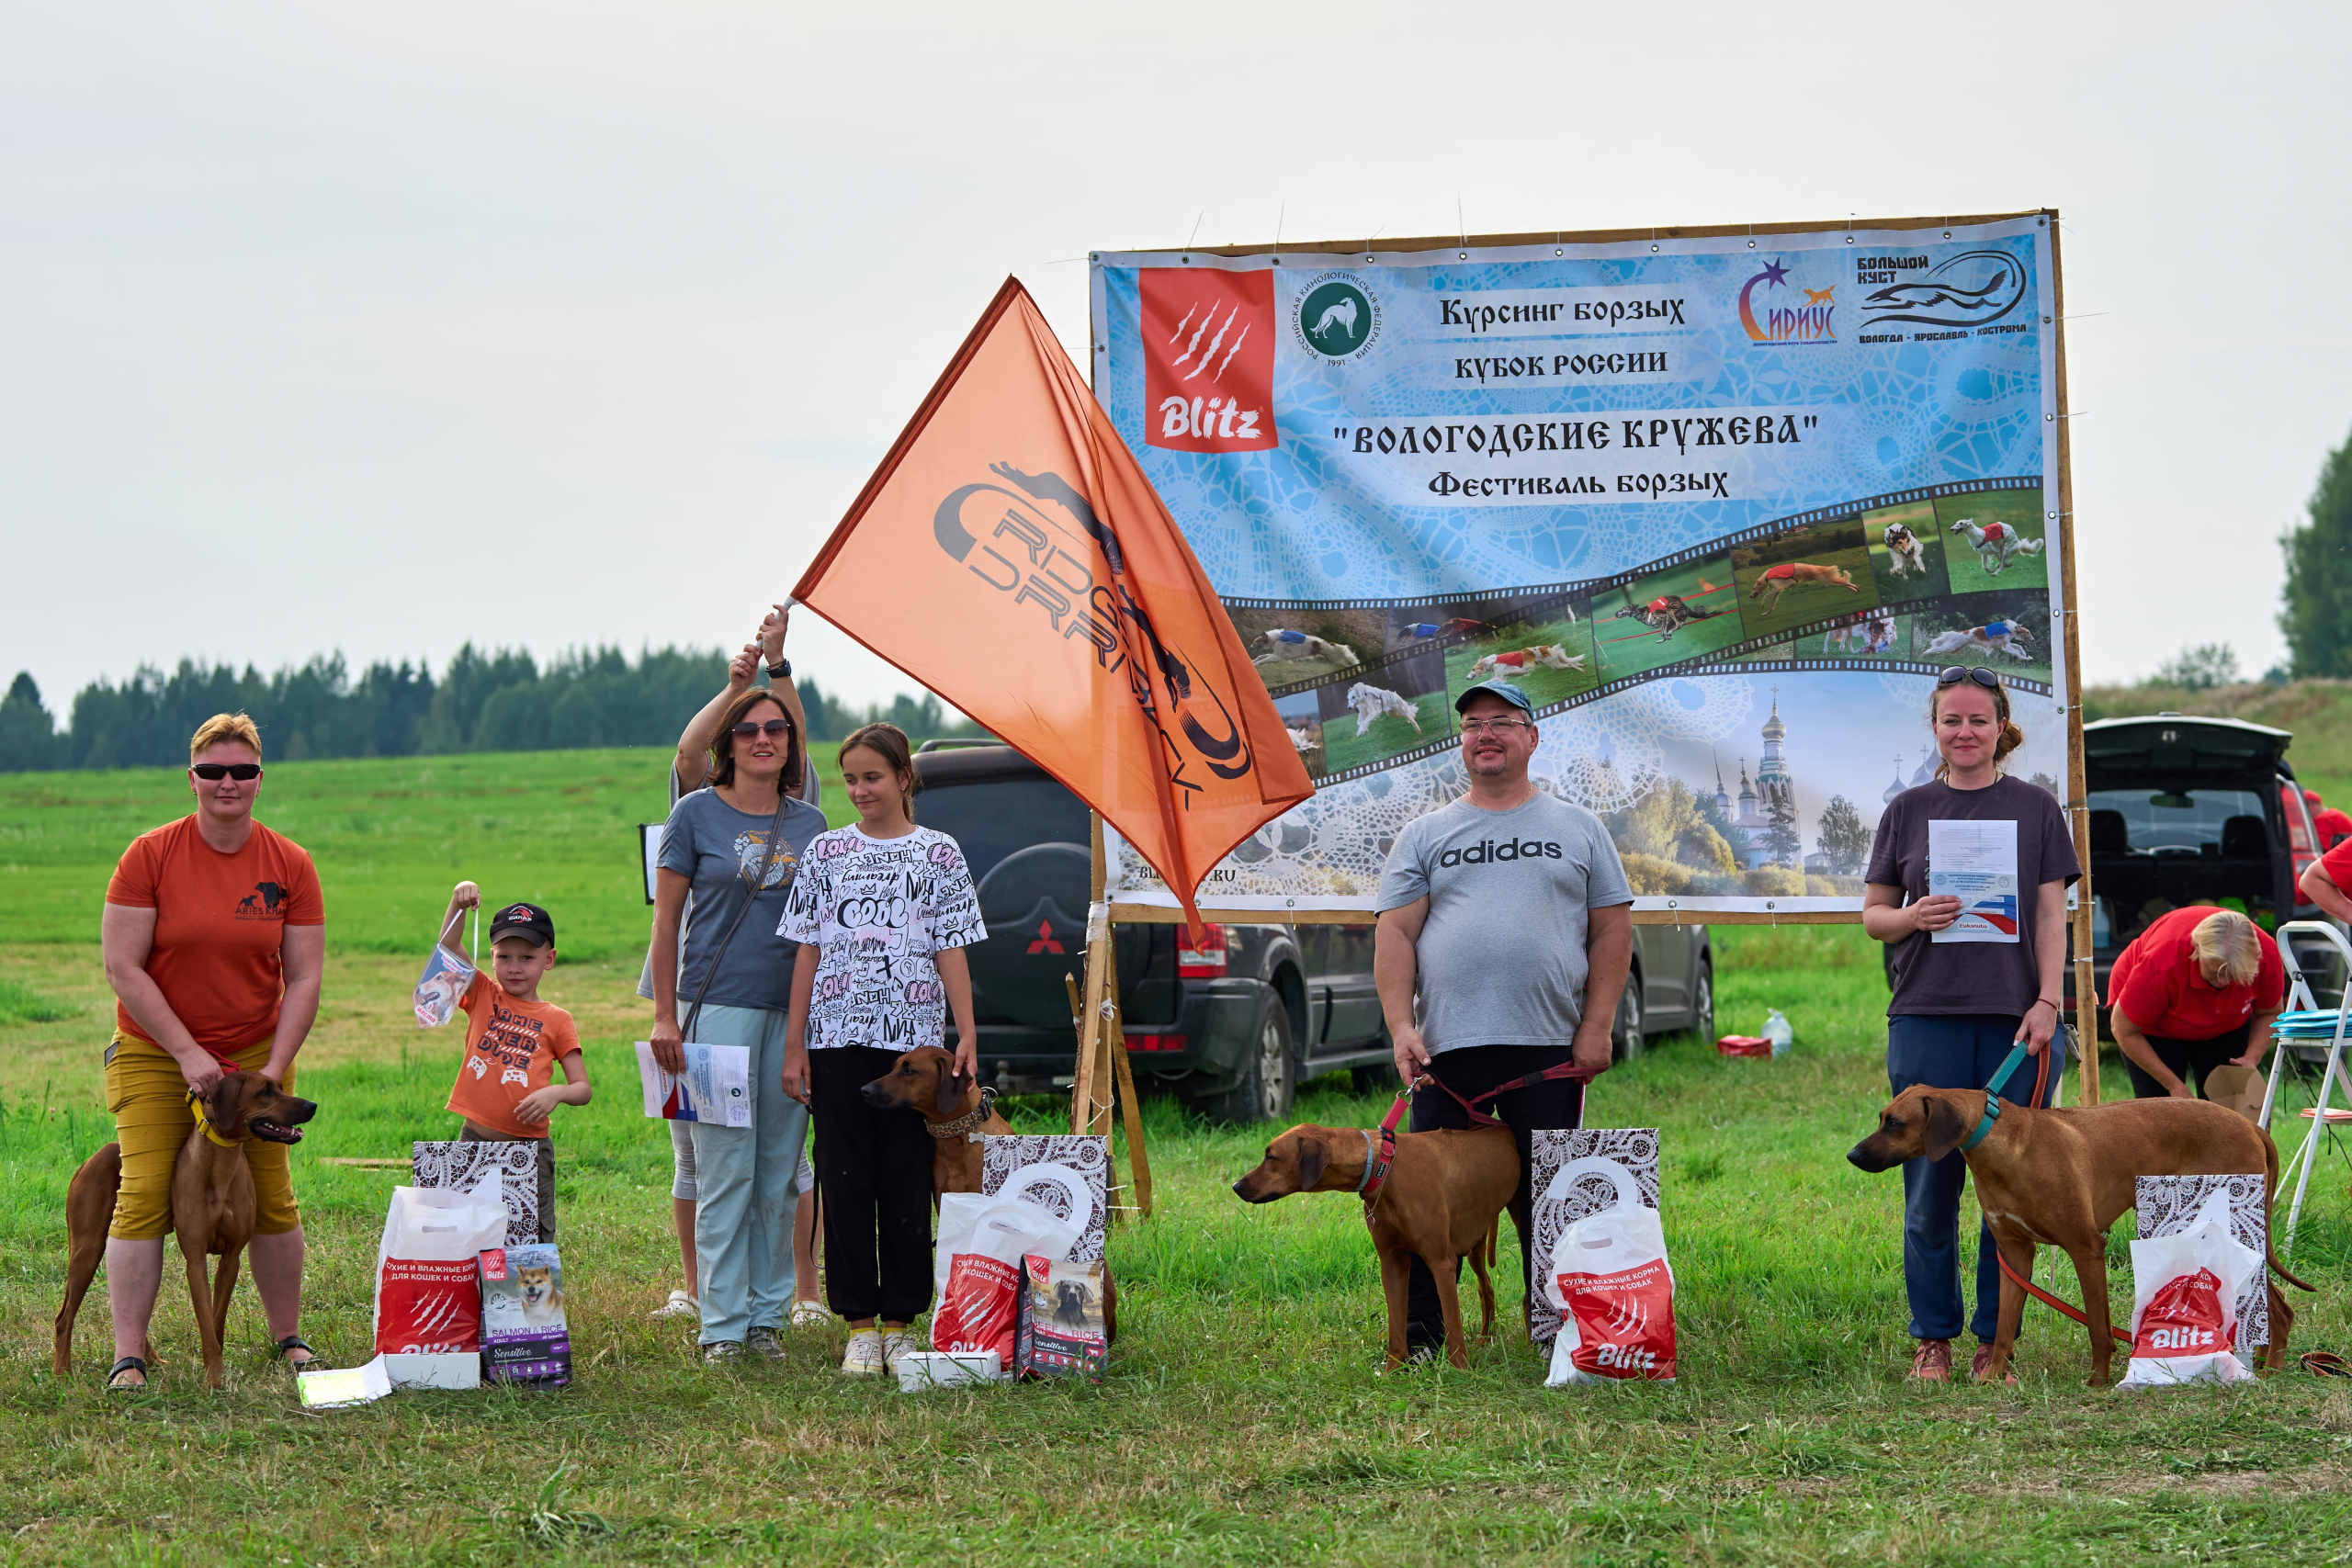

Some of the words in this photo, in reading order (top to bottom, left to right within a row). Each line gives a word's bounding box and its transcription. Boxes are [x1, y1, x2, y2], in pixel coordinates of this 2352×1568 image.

[1857, 254, 1928, 270] БОЛЬШОЙ
[1857, 271, 1897, 284] КУСТ
[1299, 271, 1378, 303] КИНОЛОГИЧЕСКАЯ
[1440, 299, 1564, 333] Курсинг
[1575, 299, 1685, 325] борзых
[1292, 297, 1318, 359] РОССИЙСКАЯ
[1355, 306, 1382, 359] ФЕДЕРАЦИЯ
[1859, 333, 1904, 344] ВОЛОГДА
[1914, 331, 1969, 342] ЯРОСЛАВЛЬ
[1977, 324, 2027, 336] КОСТРОМА
[1159, 395, 1262, 439] Blitz
[1429, 472, 1606, 497] Фестиваль
[1618, 472, 1728, 501] борзых
[1440, 837, 1562, 869] adidas
[842, 870, 900, 886] dreaming
[235, 907, 264, 915] ARIES
[386, 1262, 408, 1271] СУХИЕ
[417, 1265, 461, 1273] ВЛАЖНЫЕ
[486, 1271, 505, 1280] Blitz
[974, 1259, 1011, 1278] ВЛАЖНЫЕ
[1032, 1269, 1047, 1282] Blitz
[391, 1272, 409, 1280] ДЛЯ
[411, 1273, 442, 1281] КОШЕК
[451, 1272, 475, 1282] СОБАК
[967, 1269, 994, 1281] КОШЕК
[995, 1276, 1001, 1284] И
[1564, 1278, 1588, 1286] СУХИЕ
[1593, 1274, 1632, 1285] ВЛАЖНЫЕ
[1632, 1266, 1660, 1279] КОРМА
[1576, 1287, 1591, 1295] ДЛЯ
[1626, 1278, 1653, 1289] СОБАК
[2189, 1281, 2213, 1292] СОБАК
[492, 1326, 531, 1337] SALMON
[540, 1324, 562, 1334] RICE
[1071, 1329, 1099, 1340] RICE
[2150, 1324, 2215, 1348] Blitz
[1035, 1336, 1069, 1351] Sensitive
[494, 1347, 532, 1359] Sensitive
[1597, 1343, 1656, 1370] Blitz
